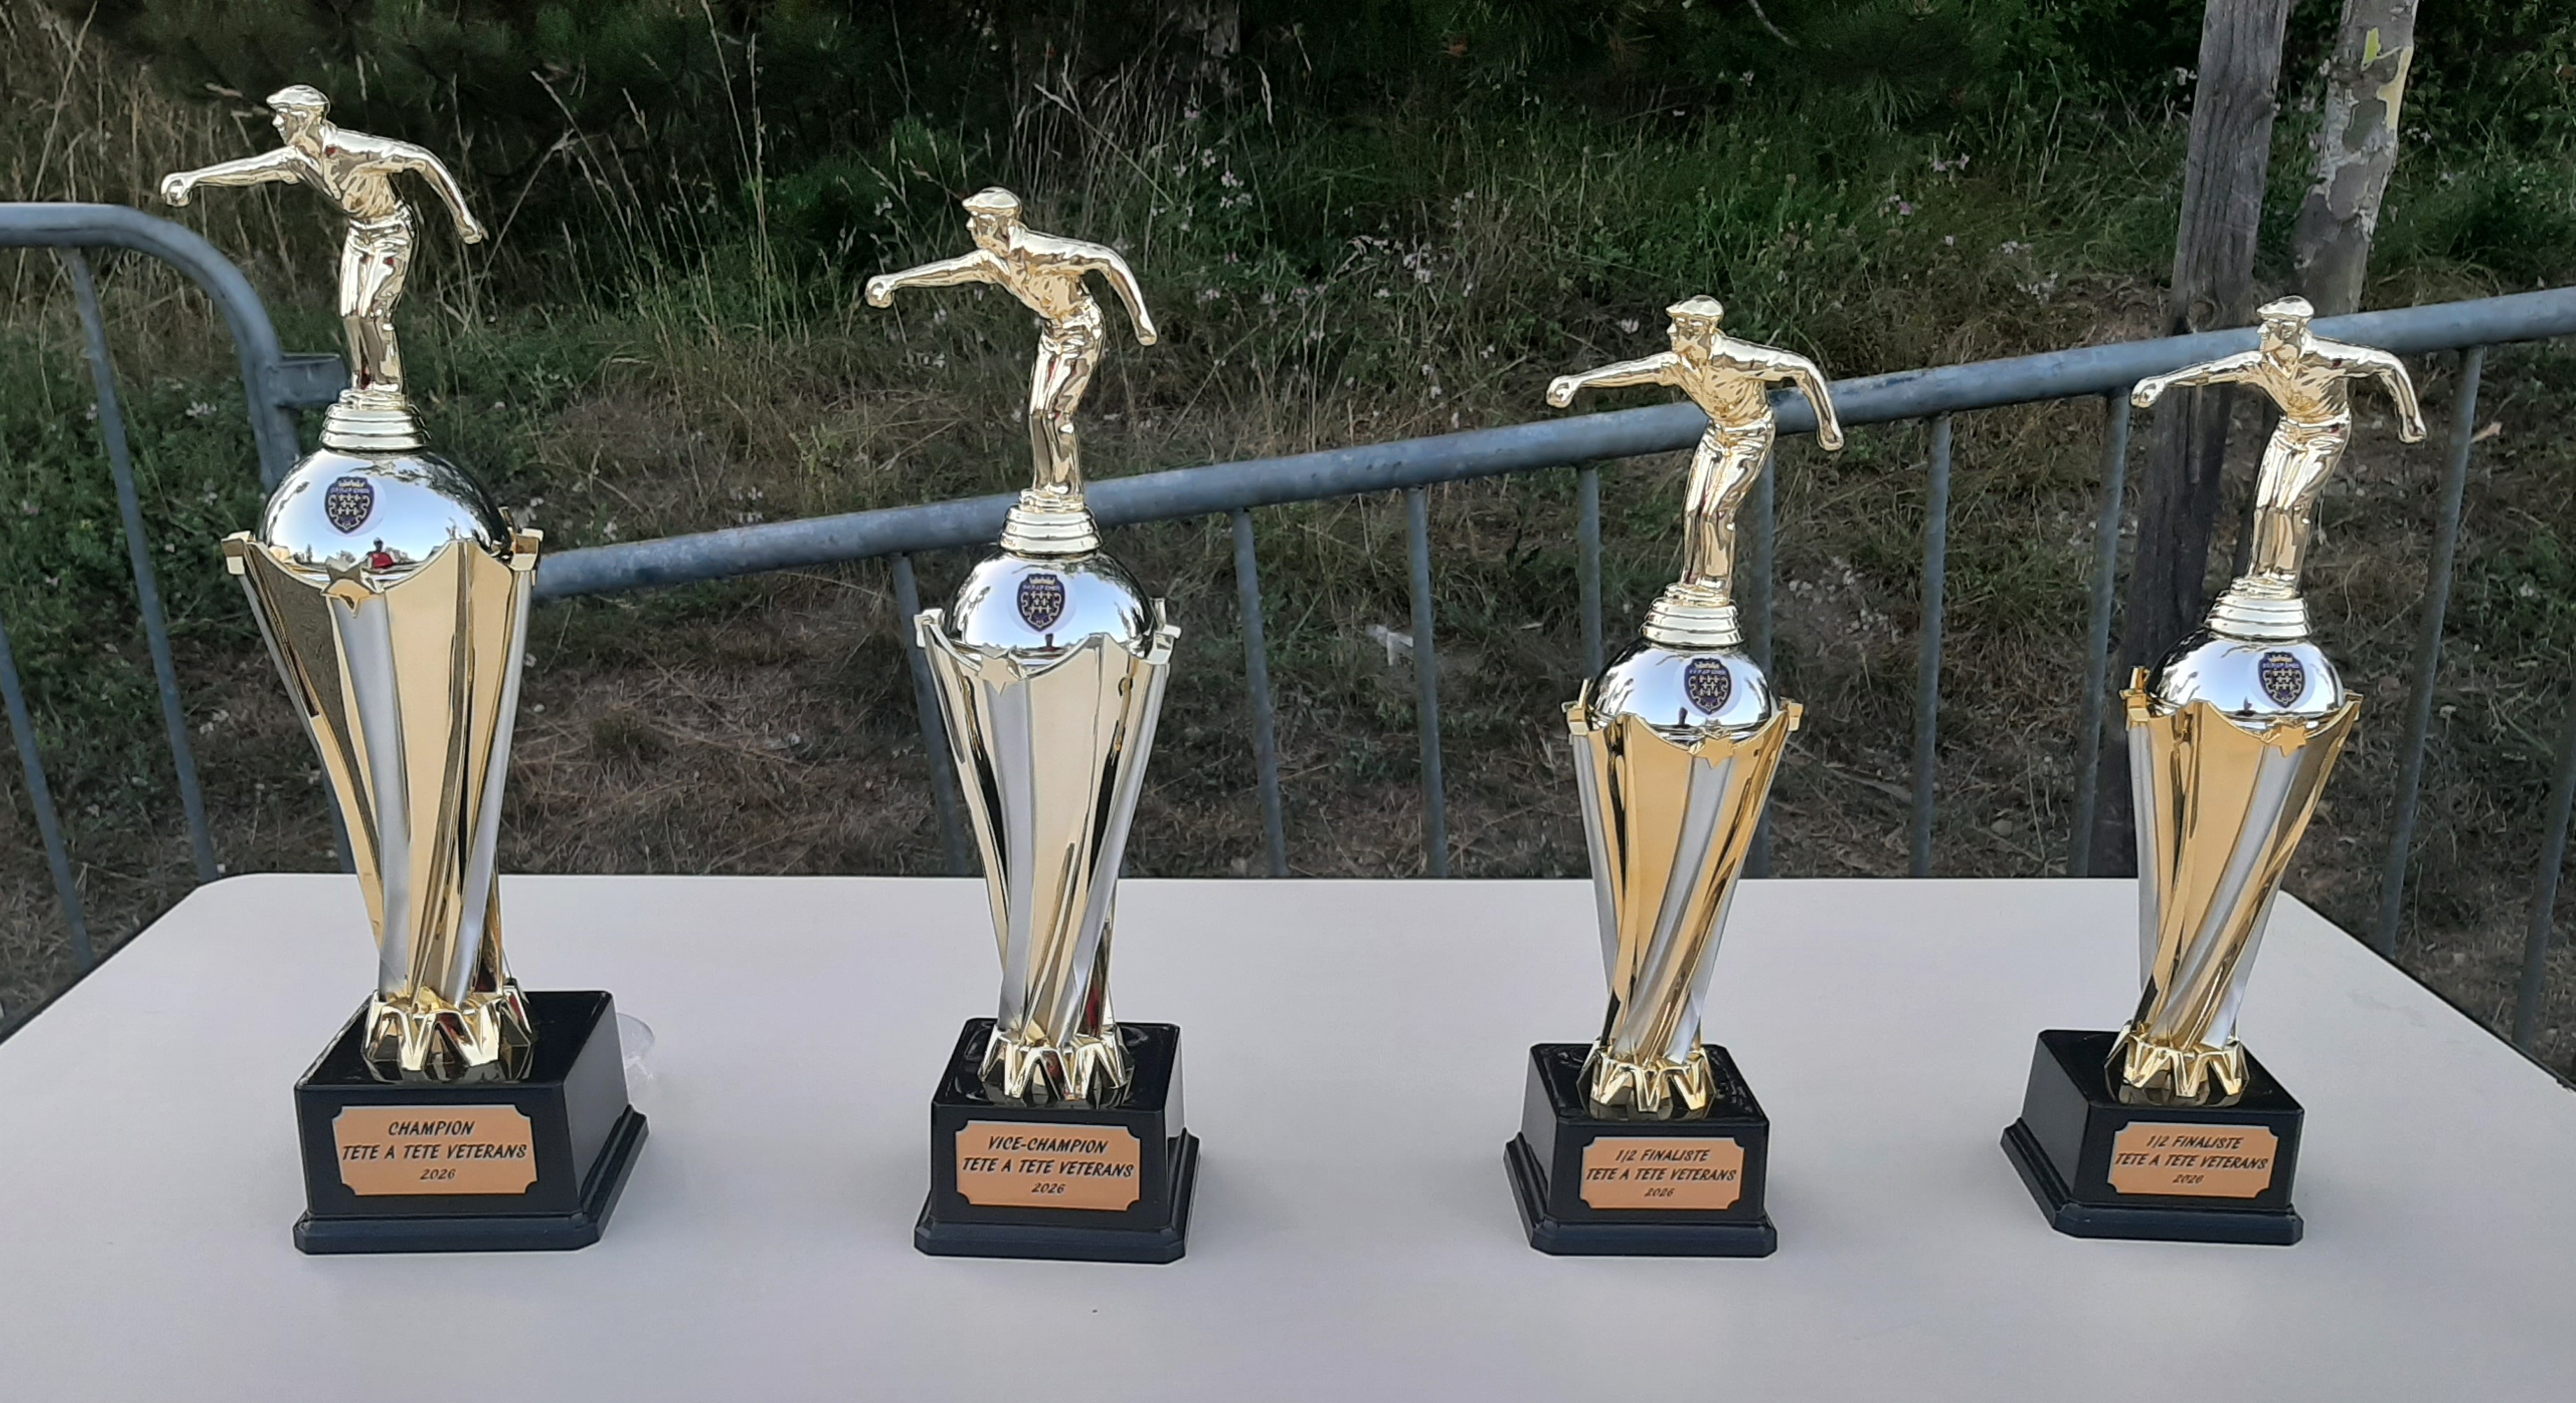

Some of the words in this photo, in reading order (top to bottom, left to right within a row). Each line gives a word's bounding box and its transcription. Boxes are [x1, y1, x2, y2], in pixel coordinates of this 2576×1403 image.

[388, 1121, 475, 1136] CHAMPION
[988, 1136, 1109, 1153] VICE-CHAMPION
[2172, 1136, 2244, 1149] FINALISTE
[343, 1145, 380, 1160] TETE
[385, 1145, 395, 1160] A
[404, 1144, 441, 1159] TETE
[447, 1144, 527, 1159] VETERANS
[1640, 1149, 1710, 1162] FINALISTE
[963, 1158, 999, 1171] TETE
[1001, 1160, 1011, 1172] A
[1018, 1160, 1055, 1174] TETE
[1058, 1161, 1134, 1177] VETERANS
[2115, 1153, 2149, 1166] TETE
[2149, 1155, 2159, 1166] A
[2164, 1155, 2198, 1167] TETE
[2200, 1156, 2268, 1169] VETERANS
[420, 1169, 456, 1180] 2026
[1586, 1168, 1618, 1181] TETE
[1619, 1169, 1628, 1181] A
[1635, 1168, 1667, 1181] TETE
[1670, 1168, 1737, 1181] VETERANS
[2172, 1174, 2204, 1183] 2026
[1031, 1183, 1066, 1194] 2026
[1644, 1188, 1675, 1197] 2026
